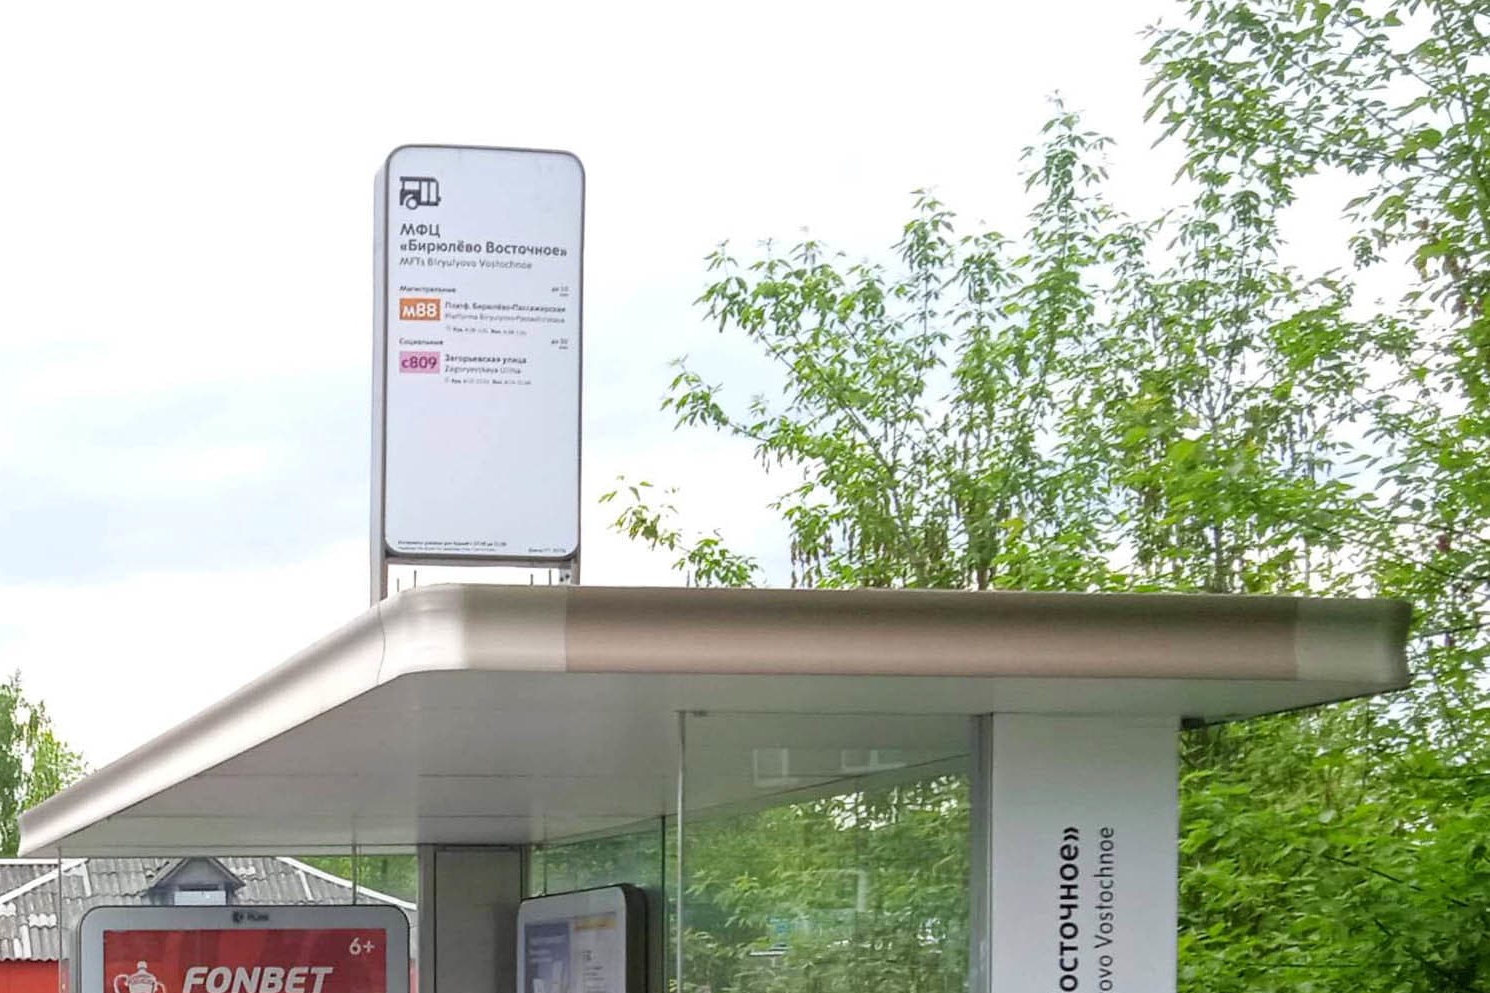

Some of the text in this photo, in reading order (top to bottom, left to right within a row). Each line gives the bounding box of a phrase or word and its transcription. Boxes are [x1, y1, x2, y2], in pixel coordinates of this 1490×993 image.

[399, 223, 441, 238] МФЦ
[400, 239, 568, 257] «Бирюлёво Восточное»
[401, 356, 438, 370] с809
[1093, 826, 1115, 949] Vostochnoe
[348, 937, 375, 955] 6+
